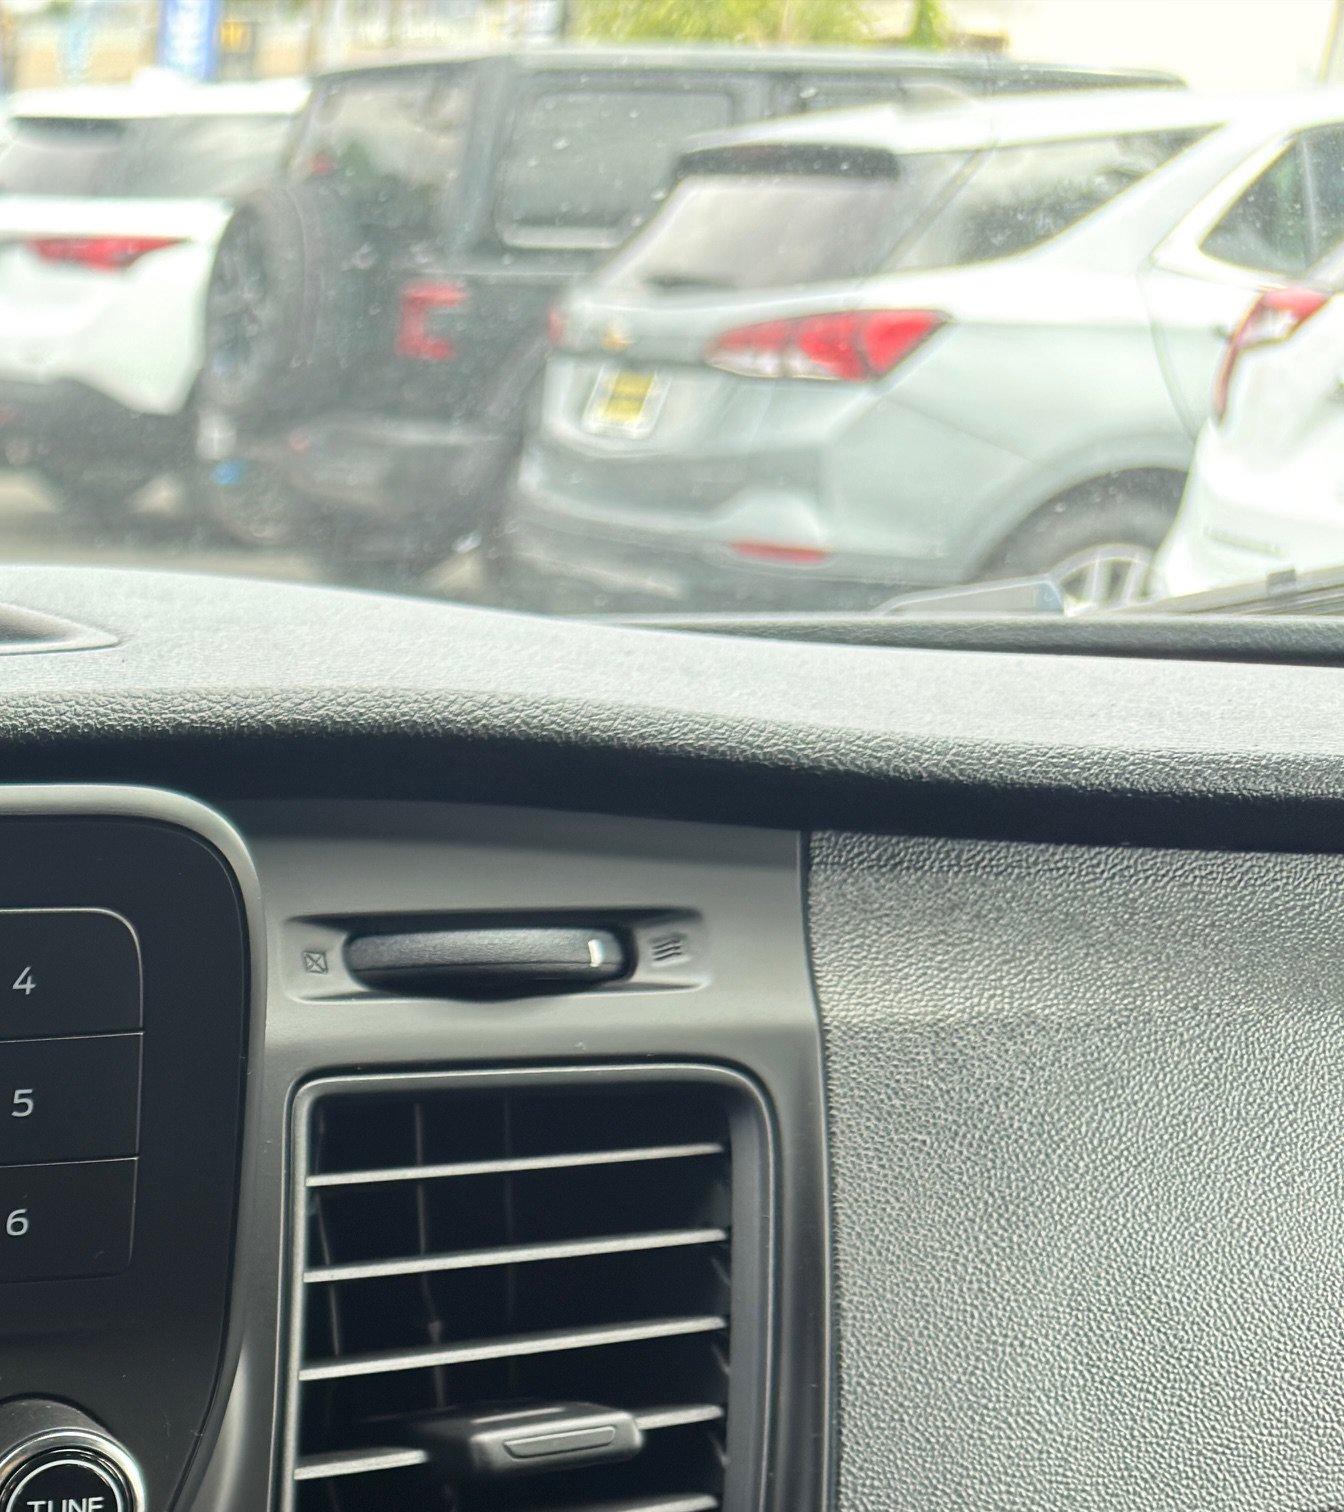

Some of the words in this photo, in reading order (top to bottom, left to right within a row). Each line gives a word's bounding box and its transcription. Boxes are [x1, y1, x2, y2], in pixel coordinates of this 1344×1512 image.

[12, 966, 36, 995] 4
[11, 1088, 34, 1117] 5
[6, 1208, 29, 1236] 6
